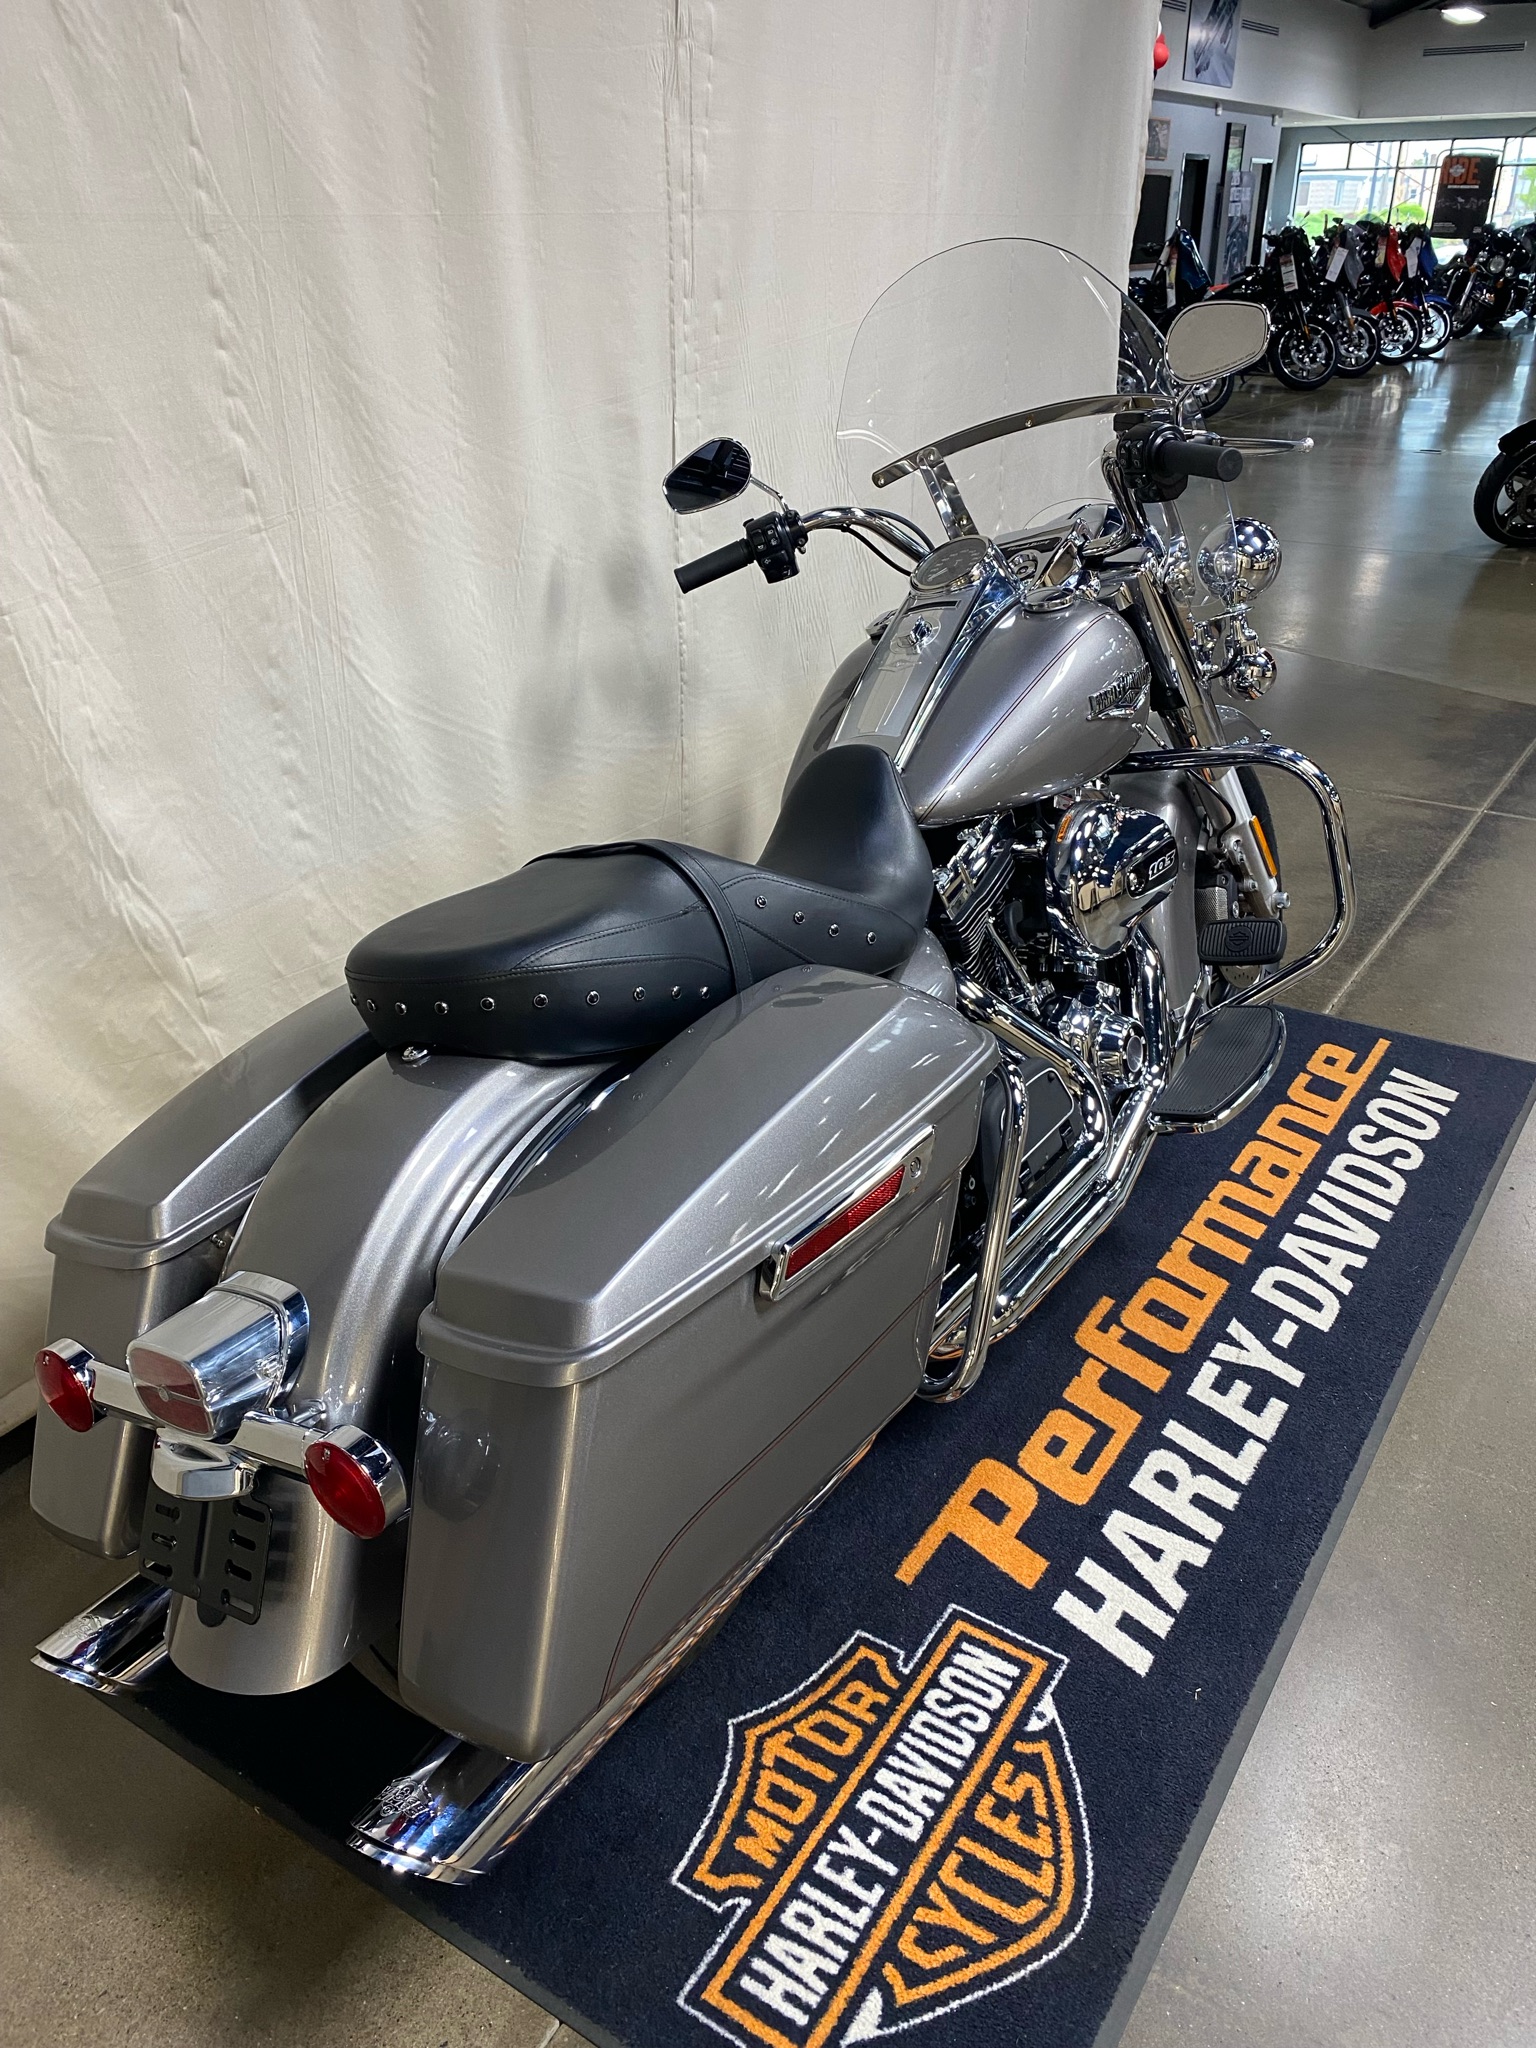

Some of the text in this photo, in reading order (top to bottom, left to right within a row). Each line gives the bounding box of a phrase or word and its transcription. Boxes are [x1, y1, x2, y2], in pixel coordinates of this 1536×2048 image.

[1148, 848, 1176, 881] 103
[896, 1038, 1391, 1590] Performance
[1051, 1067, 1460, 1679] HARLEY-DAVIDSON
[735, 1680, 890, 1868] MOTOR
[739, 1641, 1021, 2027] HARLEY-DAVIDSON
[898, 1760, 1056, 1970] CYCLES
